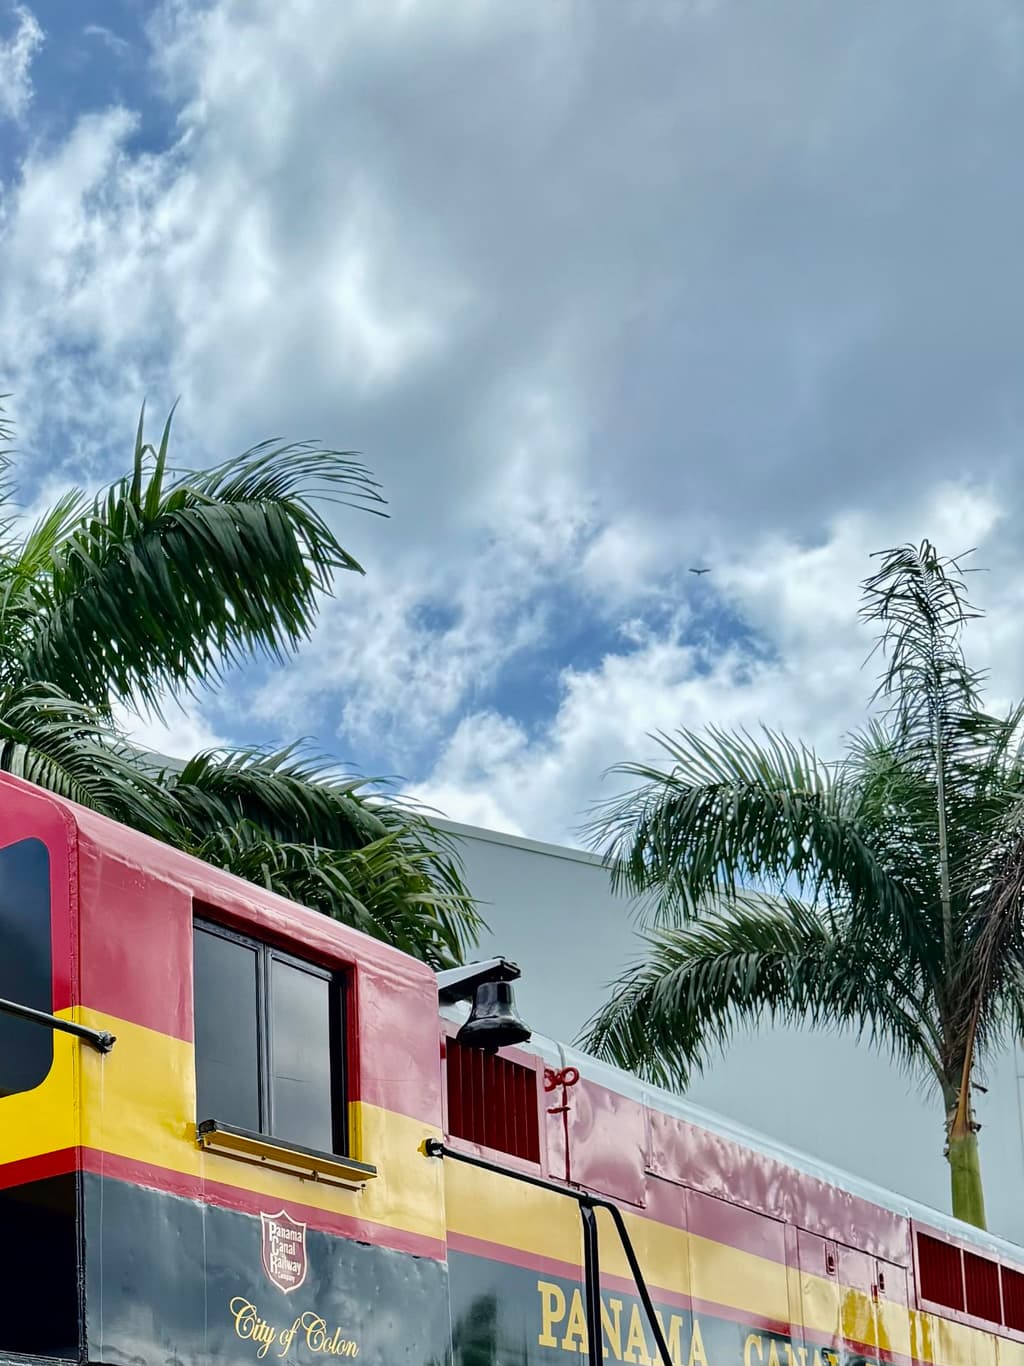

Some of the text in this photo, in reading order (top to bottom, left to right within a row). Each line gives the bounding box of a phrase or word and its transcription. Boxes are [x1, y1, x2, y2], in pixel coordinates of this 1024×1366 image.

[269, 1221, 302, 1243] Panama
[271, 1236, 296, 1256] Canal
[270, 1253, 302, 1276] Railway
[230, 1296, 359, 1358] City of Colon
